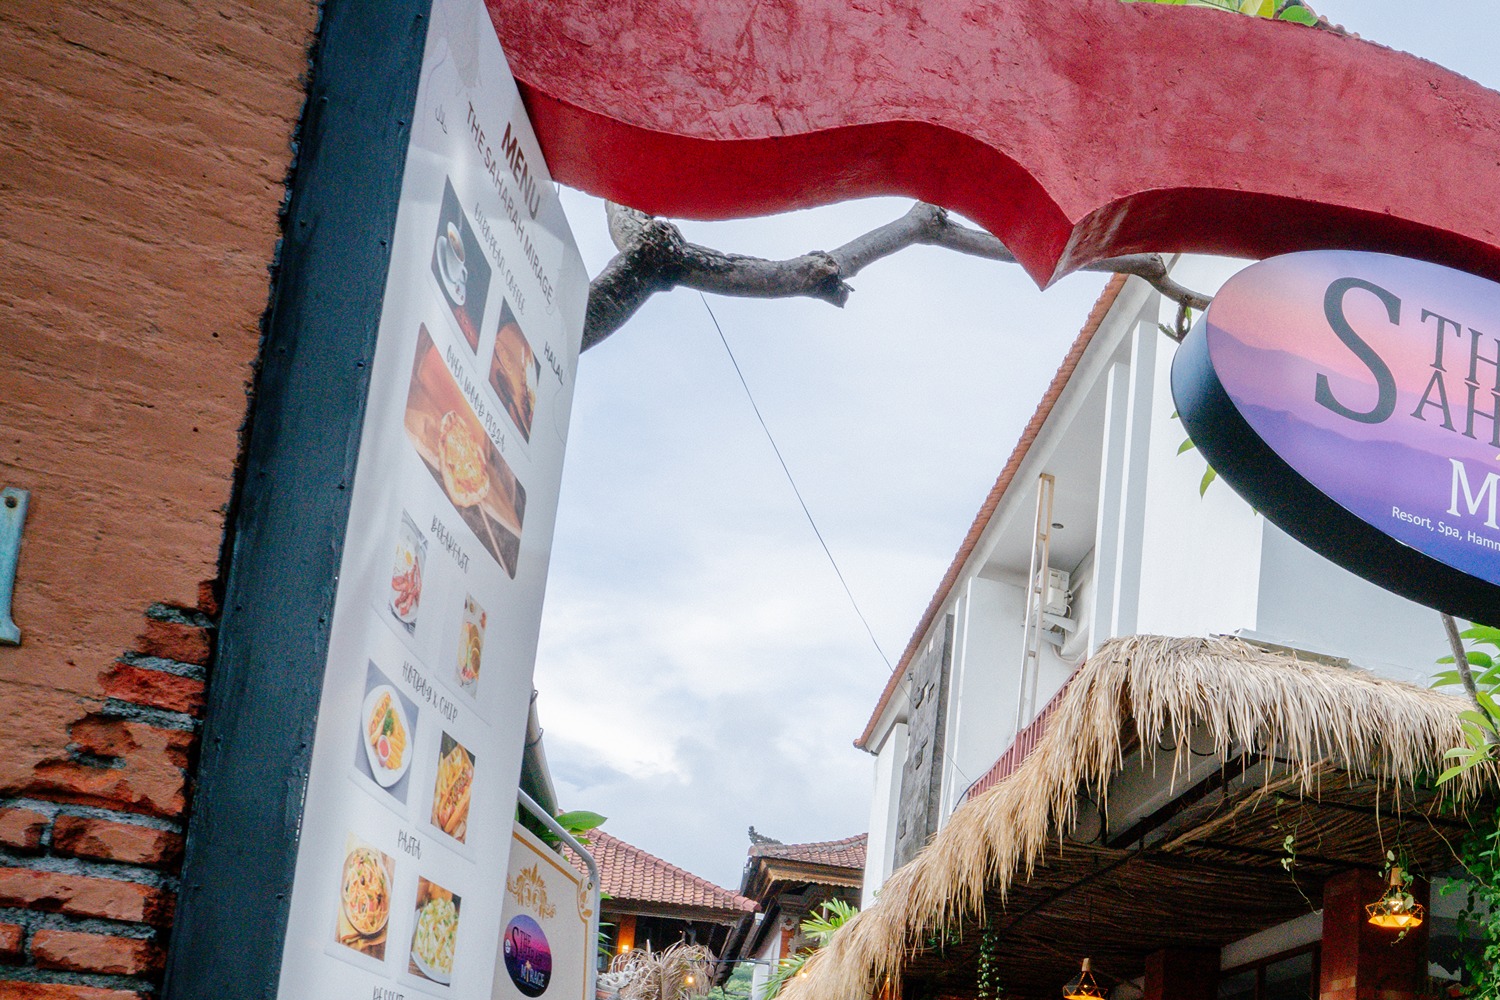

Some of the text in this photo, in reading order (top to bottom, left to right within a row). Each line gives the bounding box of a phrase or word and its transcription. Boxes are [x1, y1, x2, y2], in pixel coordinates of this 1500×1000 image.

[501, 121, 541, 221] MENU
[466, 101, 554, 305] THE SAHARAH MIRAGE
[544, 341, 564, 386] HALAL
[430, 514, 471, 575] BREAKFAST
[1392, 506, 1434, 532] Resort,
[1438, 522, 1463, 541] Spa,
[439, 696, 459, 725] CHIP
[398, 829, 422, 860] PASTA
